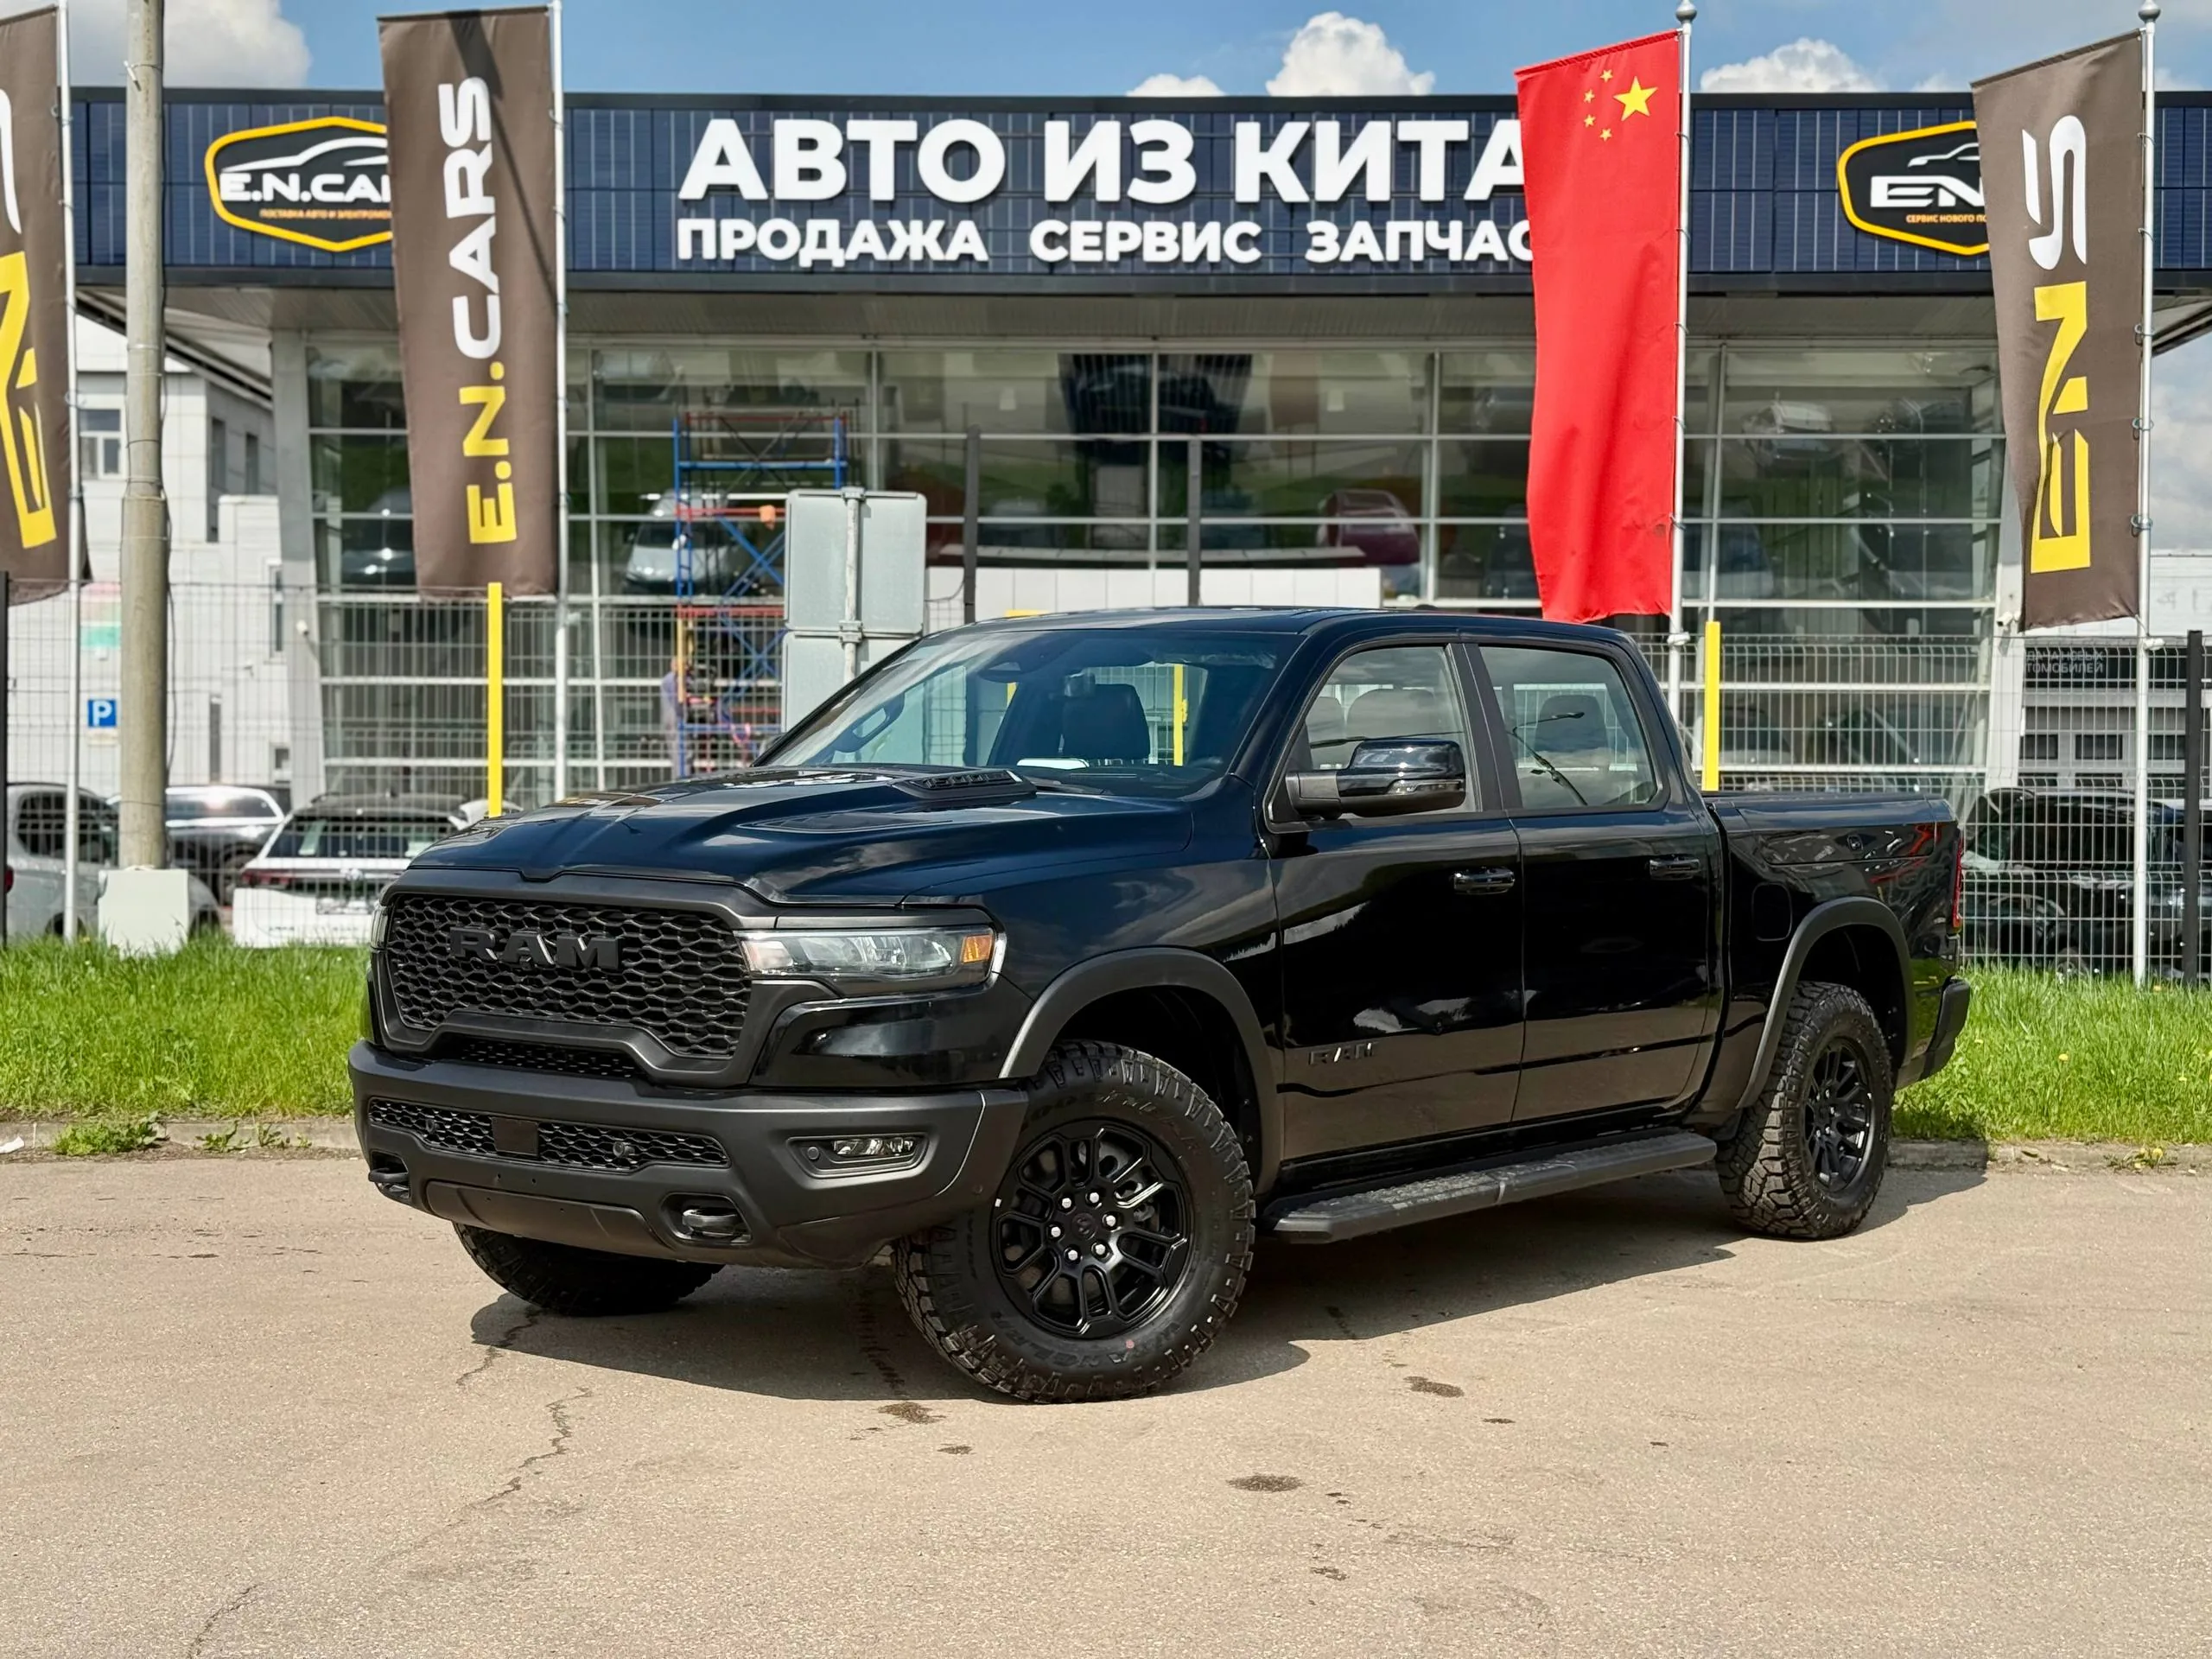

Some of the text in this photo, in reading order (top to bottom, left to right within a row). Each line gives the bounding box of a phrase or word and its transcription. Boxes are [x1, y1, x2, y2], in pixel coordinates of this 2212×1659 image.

[678, 119, 1524, 204] АВТО ИЗ КИТА
[1906, 214, 1939, 223] СЕРВИС
[1940, 214, 1975, 223] НОВОГО
[677, 219, 989, 267] ПРОДАЖА
[1029, 219, 1262, 263] СЕРВИС
[438, 76, 518, 544] E.N.CARS
[2022, 115, 2090, 574] ENS
[92, 701, 113, 726] P
[449, 926, 620, 969] RAM
